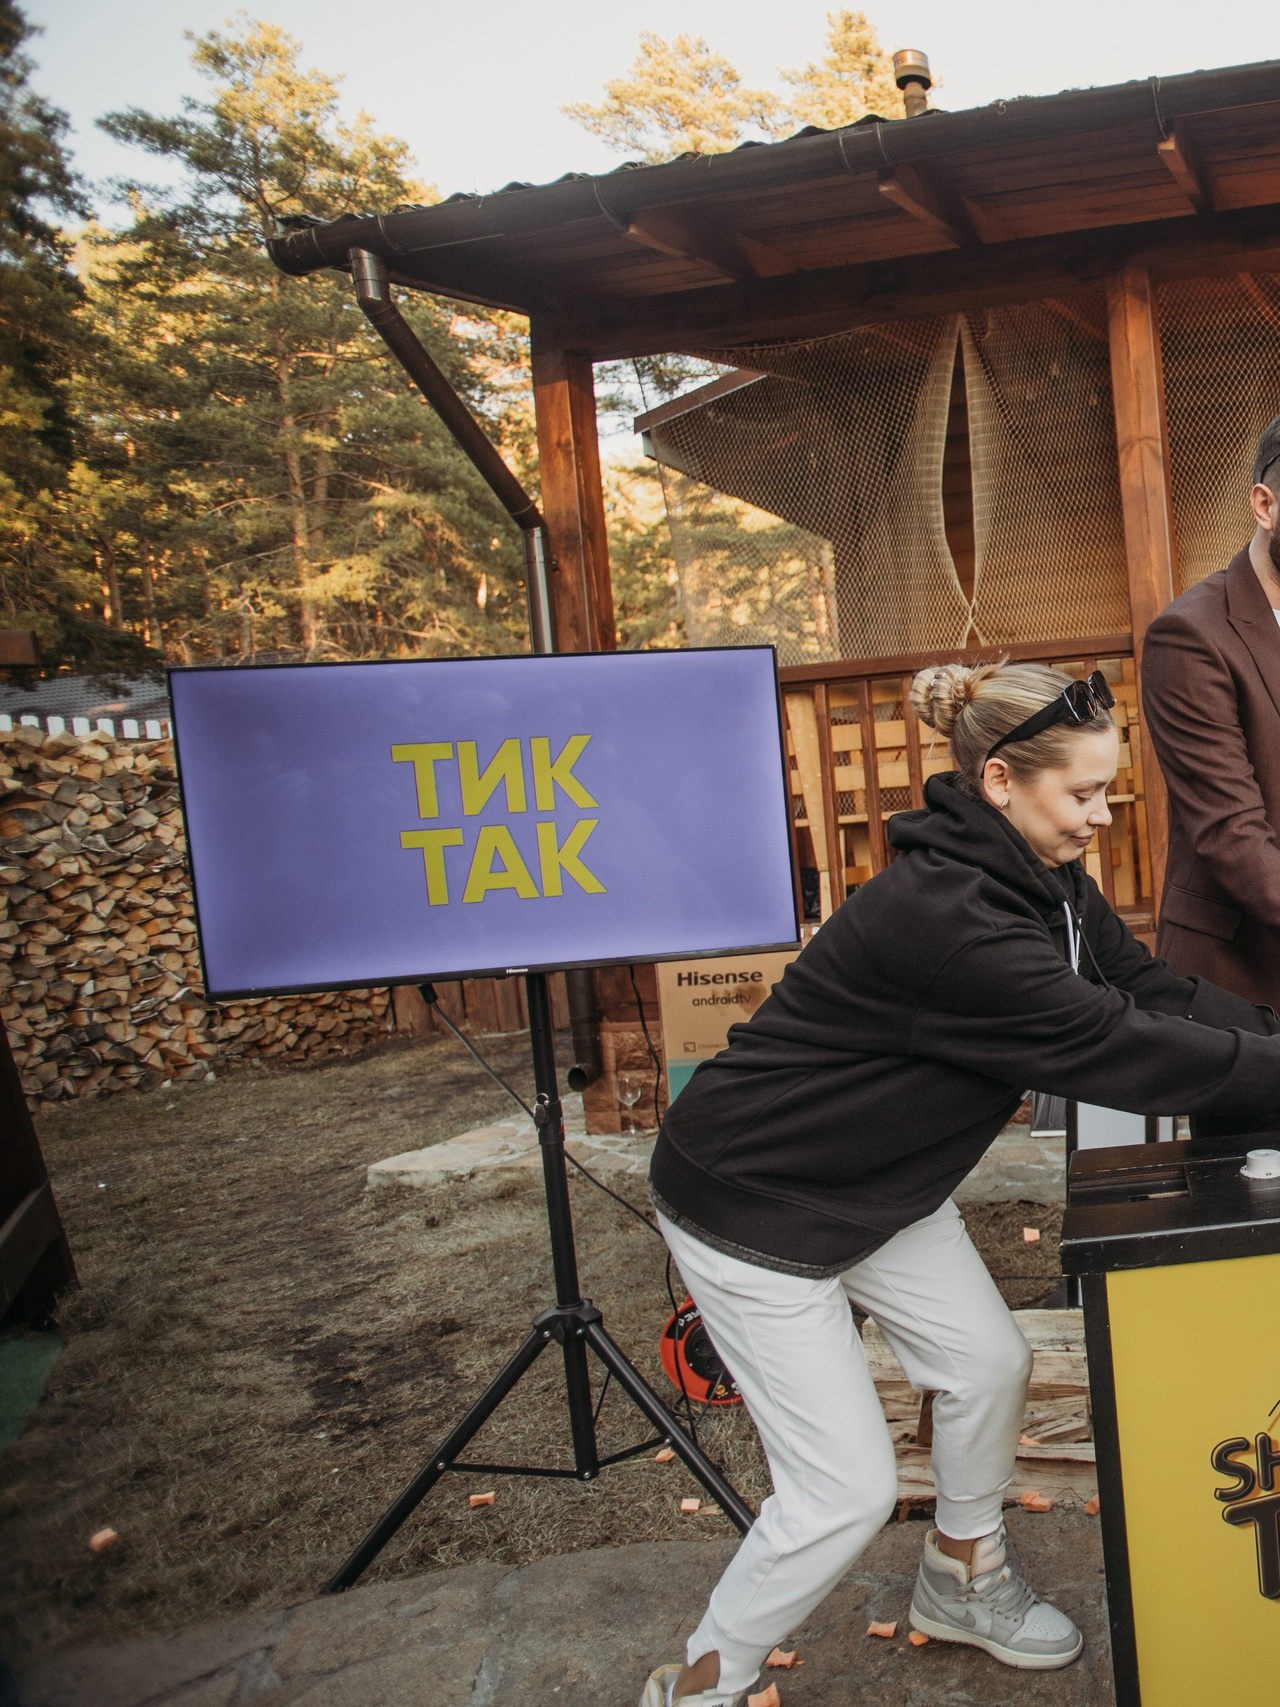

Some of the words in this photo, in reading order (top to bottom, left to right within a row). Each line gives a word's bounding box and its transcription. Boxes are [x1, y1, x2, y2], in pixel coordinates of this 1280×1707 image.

[391, 734, 599, 818] ТИК
[400, 818, 608, 906] ТАК
[677, 971, 763, 987] Hisense
